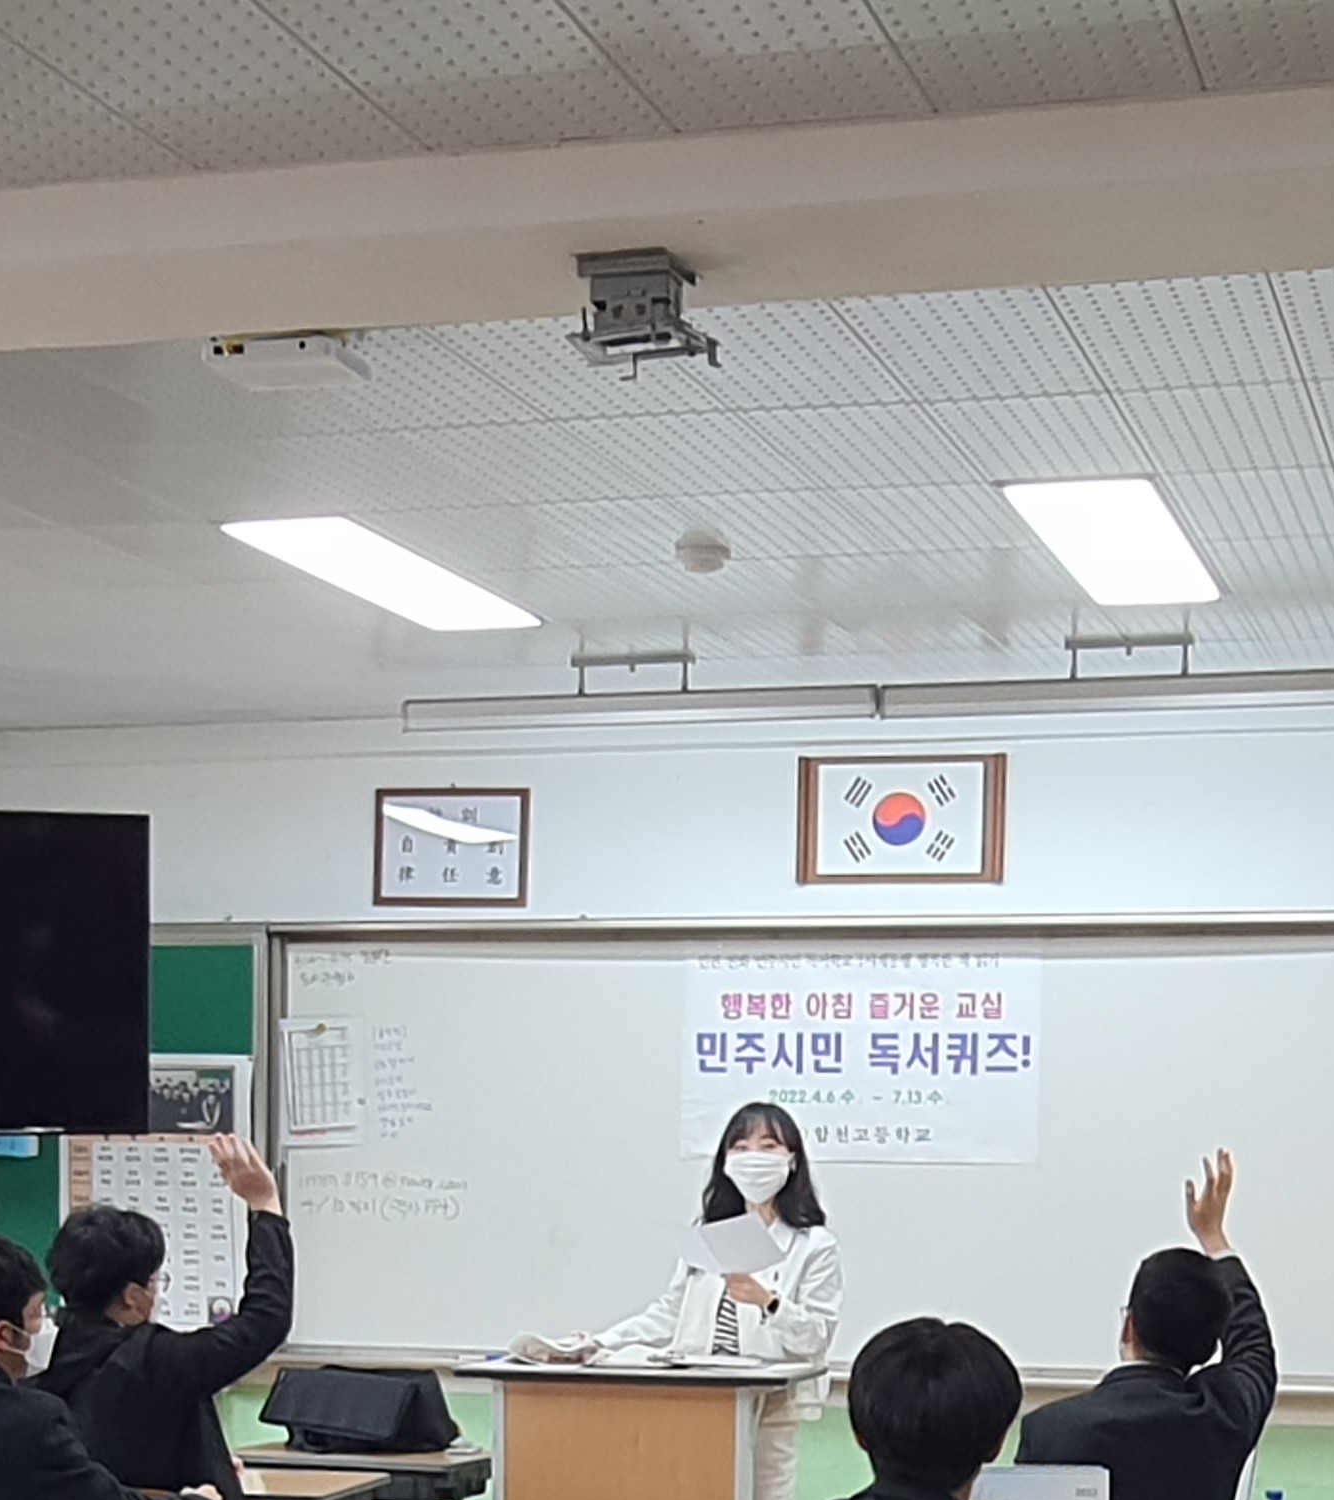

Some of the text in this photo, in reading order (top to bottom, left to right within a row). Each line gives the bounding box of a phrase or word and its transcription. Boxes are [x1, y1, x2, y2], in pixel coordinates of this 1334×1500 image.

[721, 992, 1003, 1020] 행복한 아침 즐거운 교실
[696, 1032, 1031, 1076] 민주시민 독서퀴즈!
